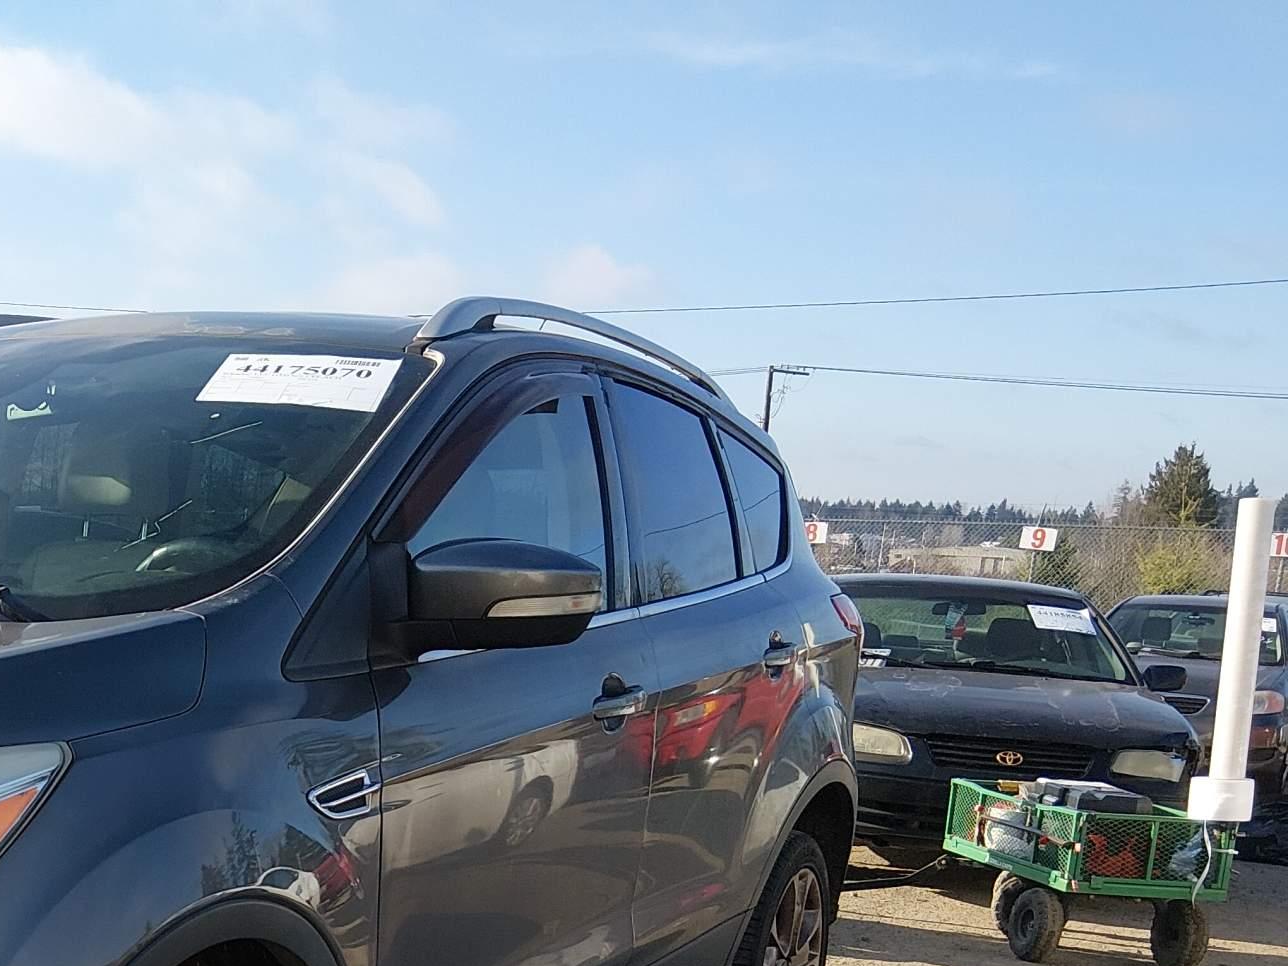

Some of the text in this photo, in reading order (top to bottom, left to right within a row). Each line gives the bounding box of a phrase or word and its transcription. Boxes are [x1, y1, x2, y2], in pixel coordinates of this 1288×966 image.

[236, 364, 373, 379] 44175070
[806, 523, 818, 542] 8
[1031, 528, 1046, 549] 9
